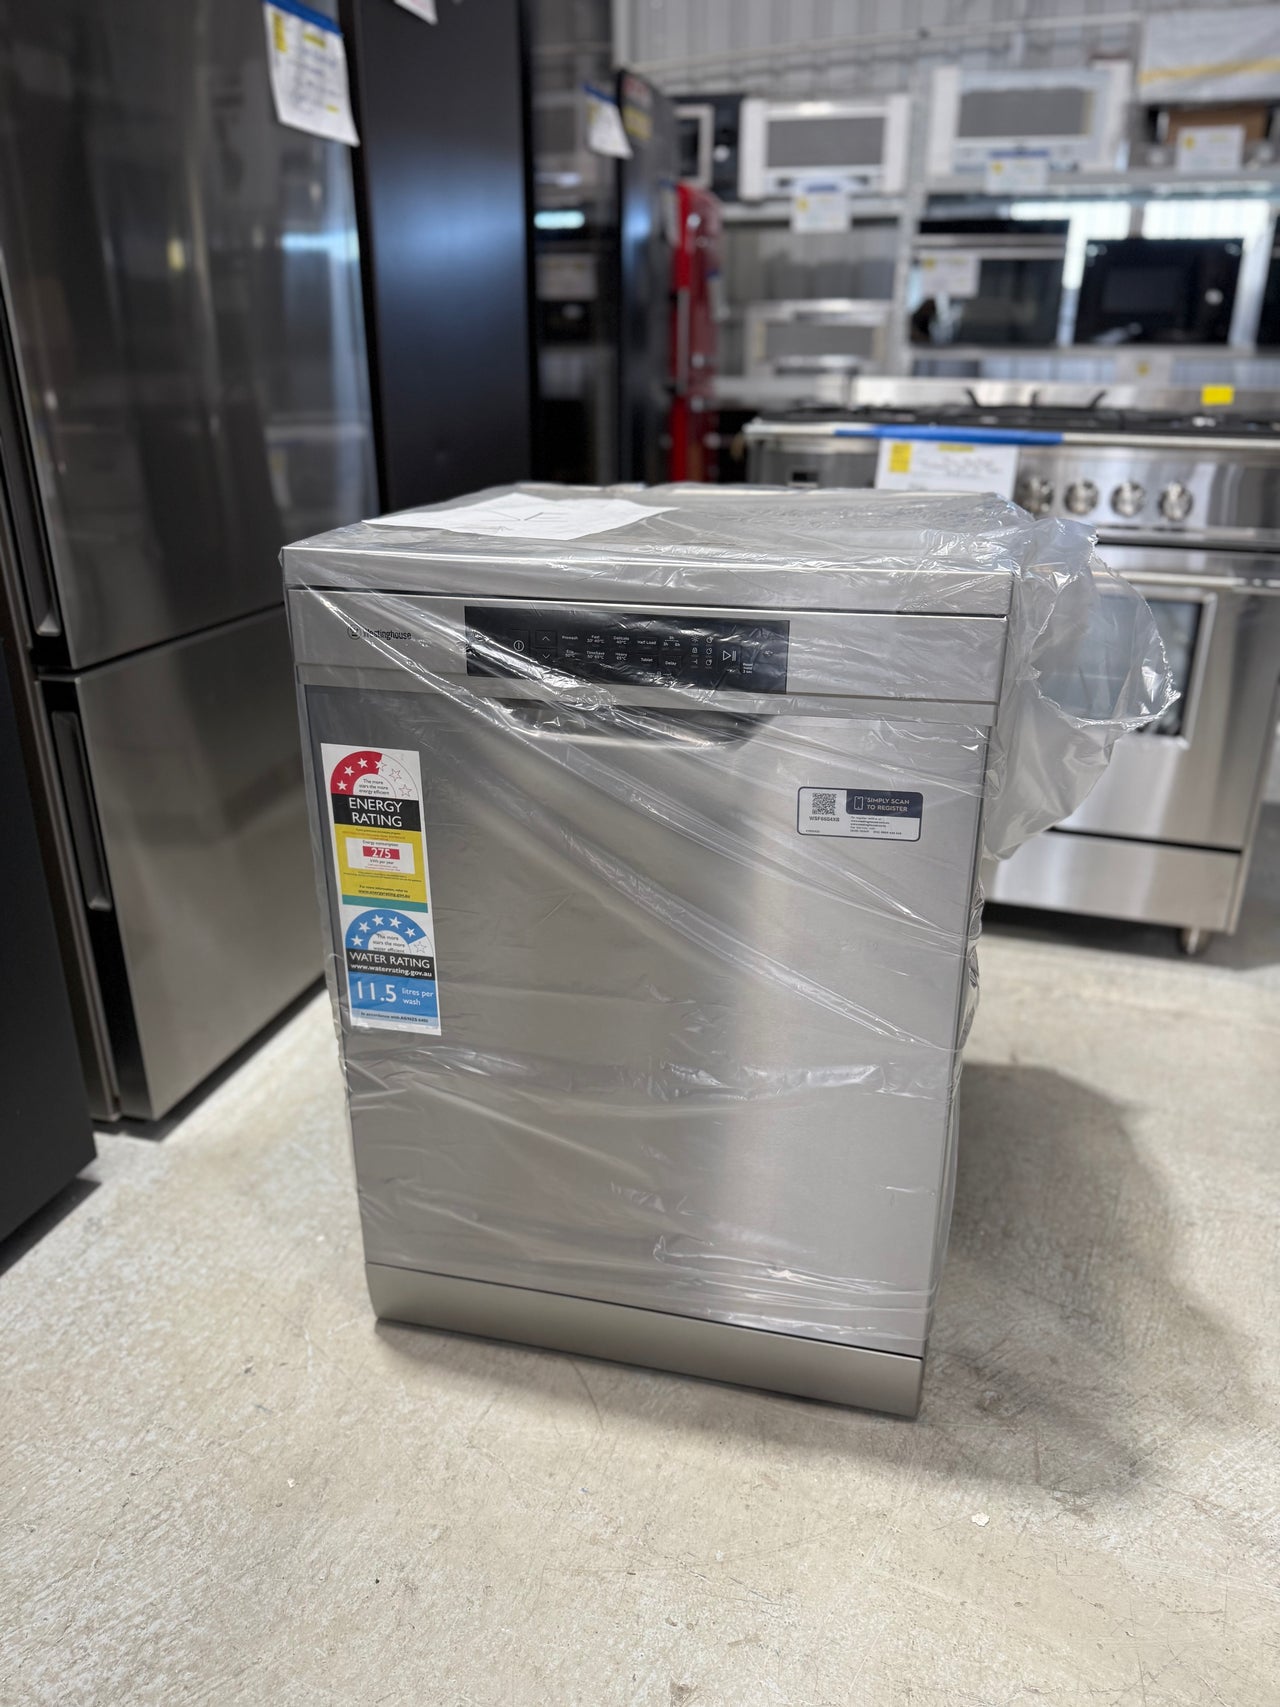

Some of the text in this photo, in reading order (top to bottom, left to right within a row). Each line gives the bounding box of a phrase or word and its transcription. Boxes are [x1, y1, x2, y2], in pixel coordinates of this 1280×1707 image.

[349, 797, 403, 813] ENERGY
[352, 812, 402, 828] RATING
[371, 847, 391, 859] 275
[349, 951, 430, 969] WATER RATING
[350, 963, 432, 977] www.waterrating.gov.au
[357, 981, 397, 1003] 11.5
[401, 988, 420, 996] litres
[402, 998, 421, 1006] wash
